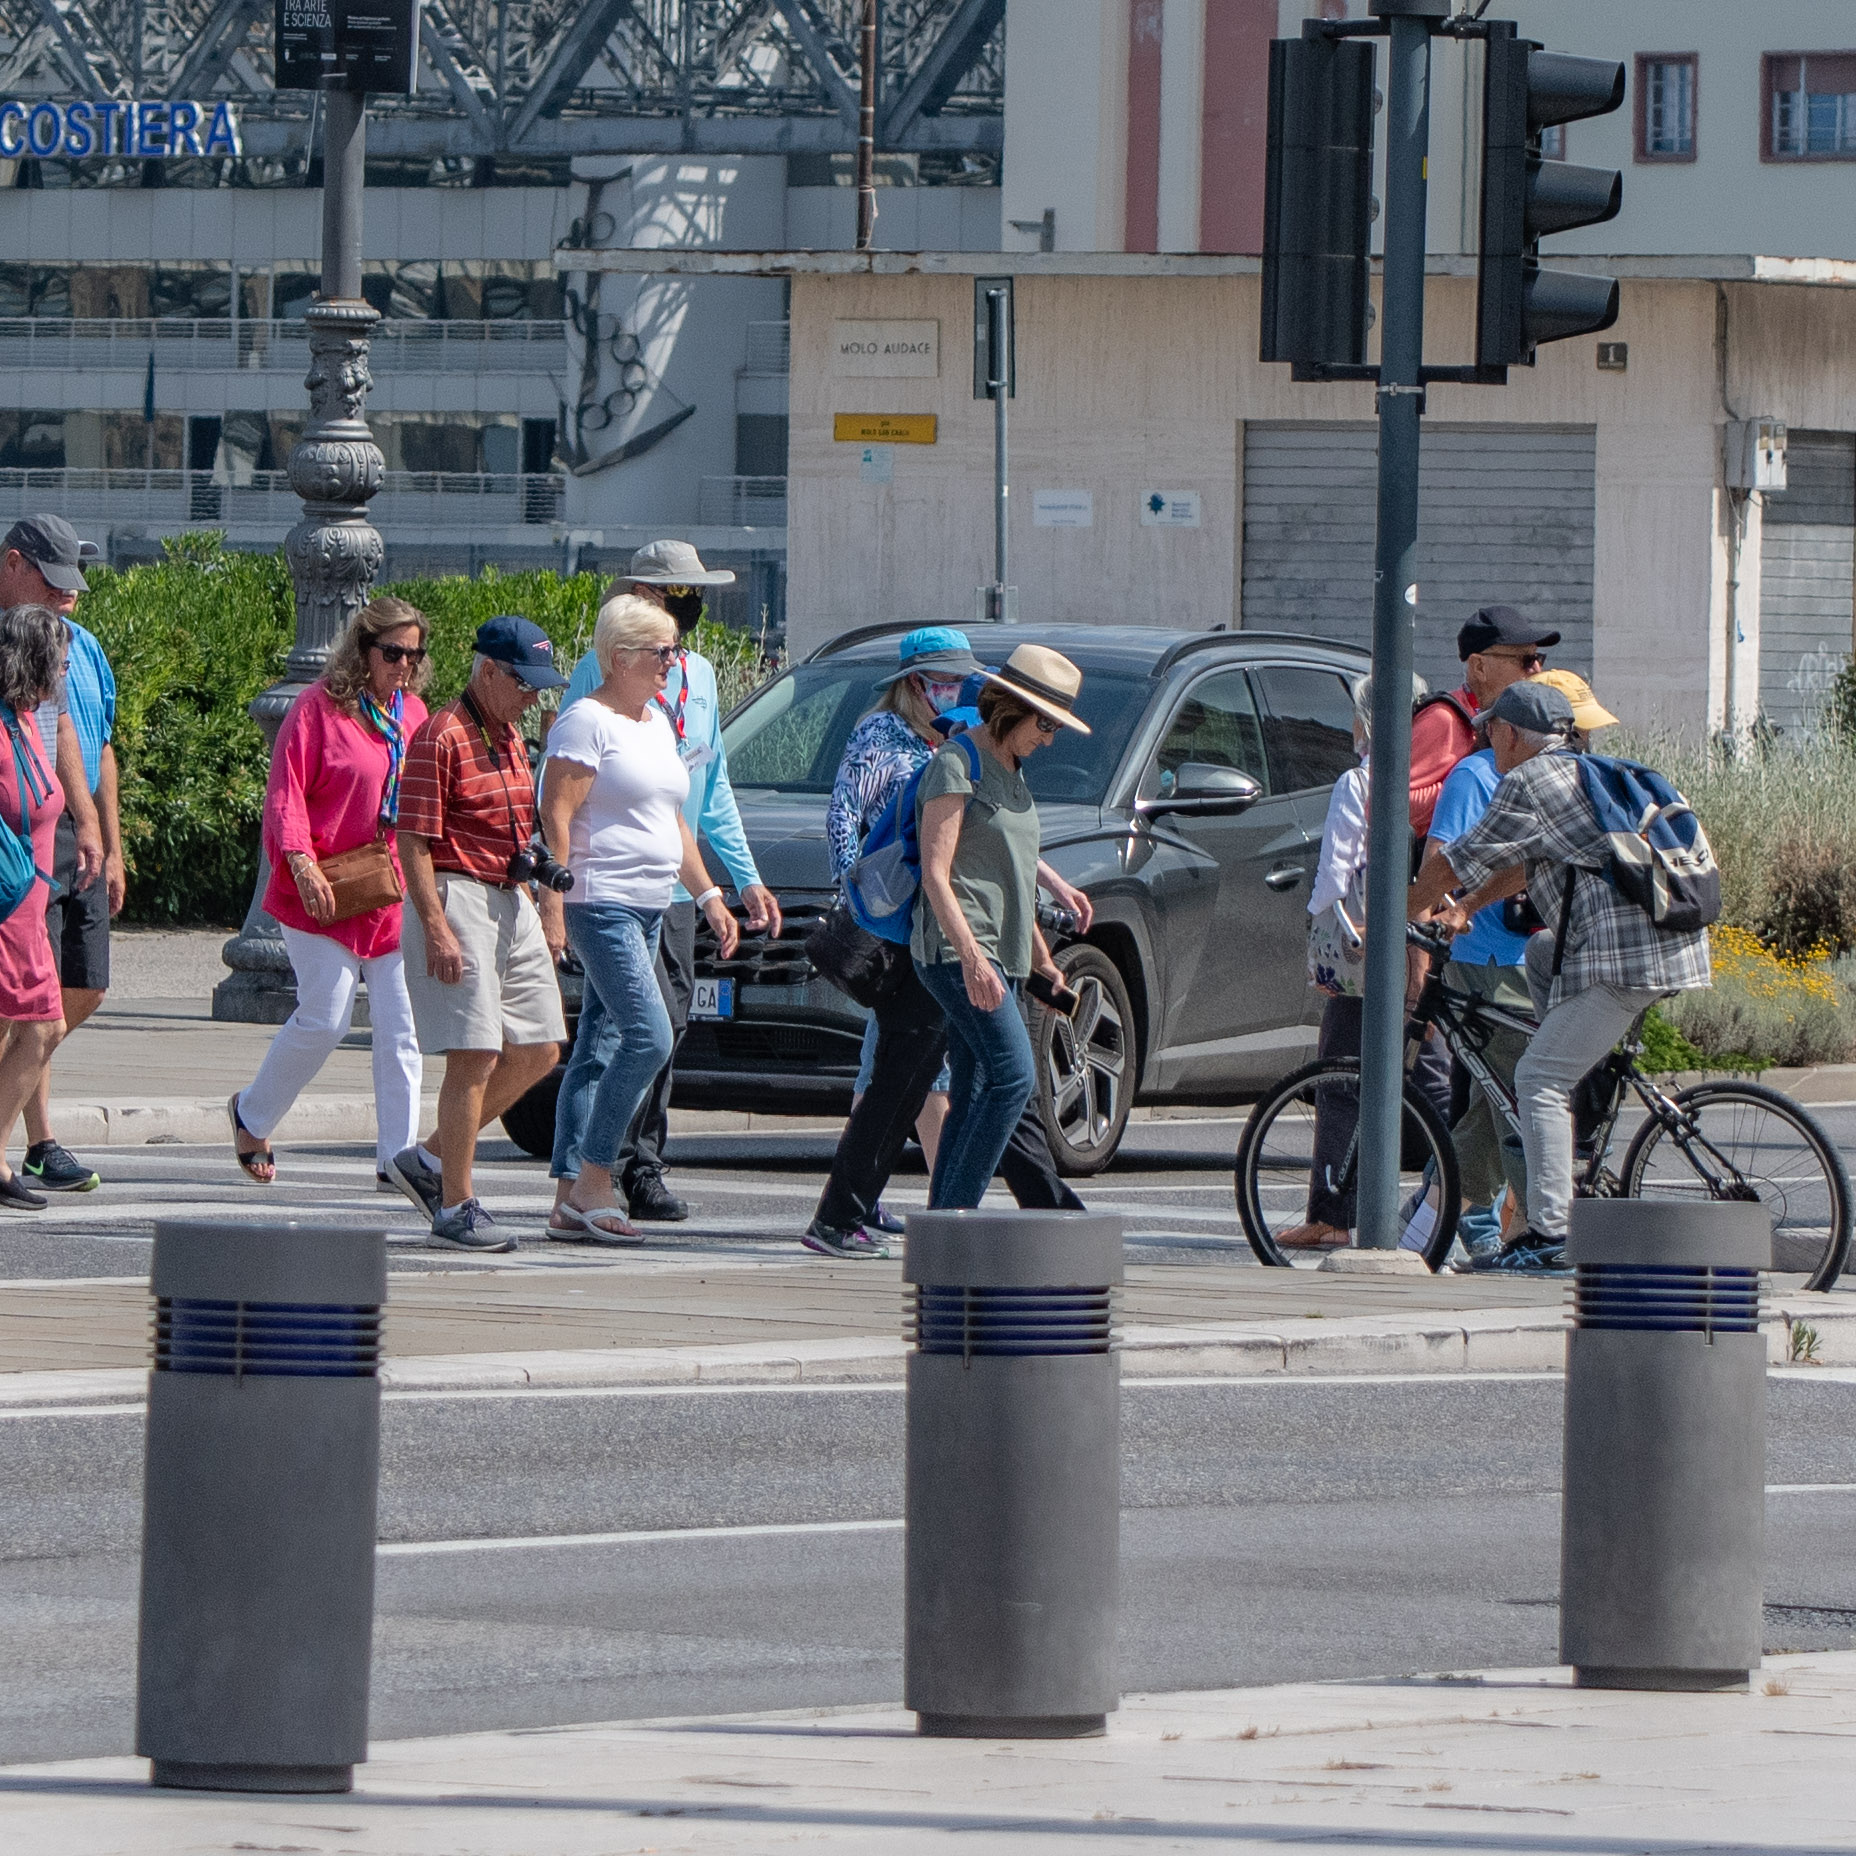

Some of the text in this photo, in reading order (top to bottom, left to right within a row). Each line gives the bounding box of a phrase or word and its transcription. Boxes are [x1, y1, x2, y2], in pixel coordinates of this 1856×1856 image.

[283, 12, 290, 27] E
[291, 13, 332, 28] SCIENZA
[840, 342, 931, 355] MOLO AUDACE
[697, 986, 716, 1008] GA
